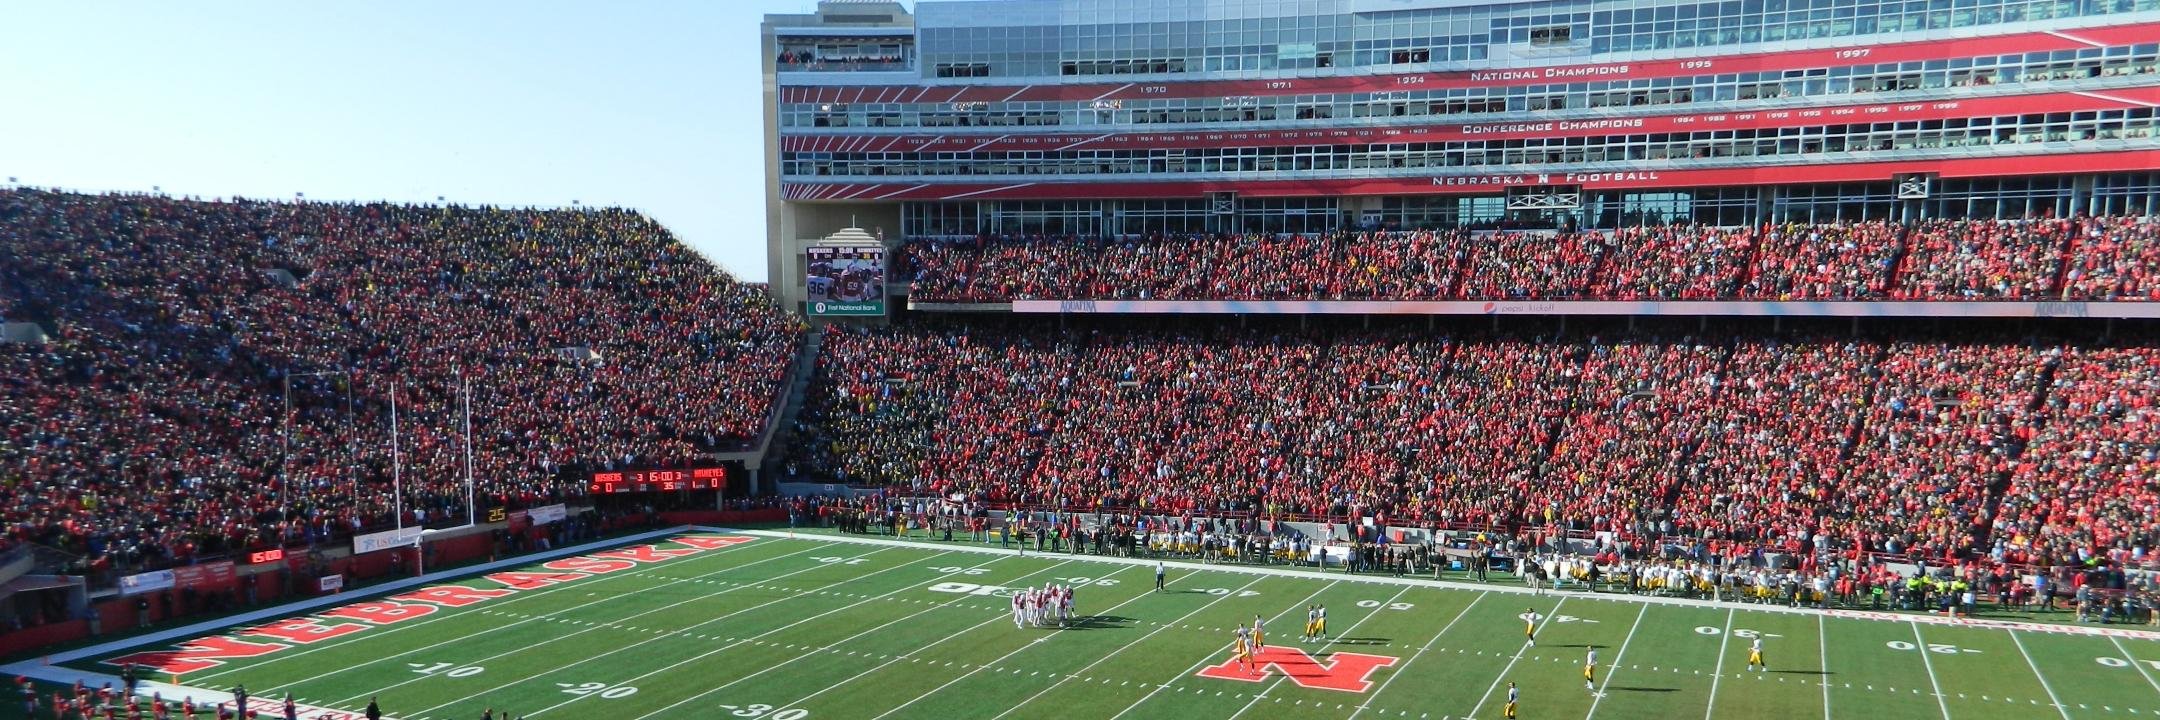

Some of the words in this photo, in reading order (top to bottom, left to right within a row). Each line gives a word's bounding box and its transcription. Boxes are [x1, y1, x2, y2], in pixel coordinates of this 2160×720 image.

[1140, 86, 1167, 94] 1970
[1266, 81, 1292, 89] 1971
[1396, 75, 1425, 84] 1994
[1471, 70, 1539, 82] NATIONAL
[1545, 64, 1629, 77] CHAMPIONS
[1680, 60, 1713, 69] 1995
[1835, 48, 1871, 59] 1997
[1462, 122, 1553, 134] CONFERENCE
[1559, 118, 1643, 130] CHAMPIONS
[1432, 175, 1524, 186] NEBRASKA
[1566, 170, 1659, 182] FOOTBALL
[808, 281, 825, 295] 36
[649, 471, 673, 481] 15:00
[605, 482, 612, 493] 0
[663, 481, 674, 490] 35
[488, 508, 505, 522] 25
[99, 536, 760, 675] NEBRASKA
[420, 662, 485, 678] 10
[1195, 645, 1400, 693] N
[571, 682, 639, 699] 20
[732, 703, 809, 720] 30
